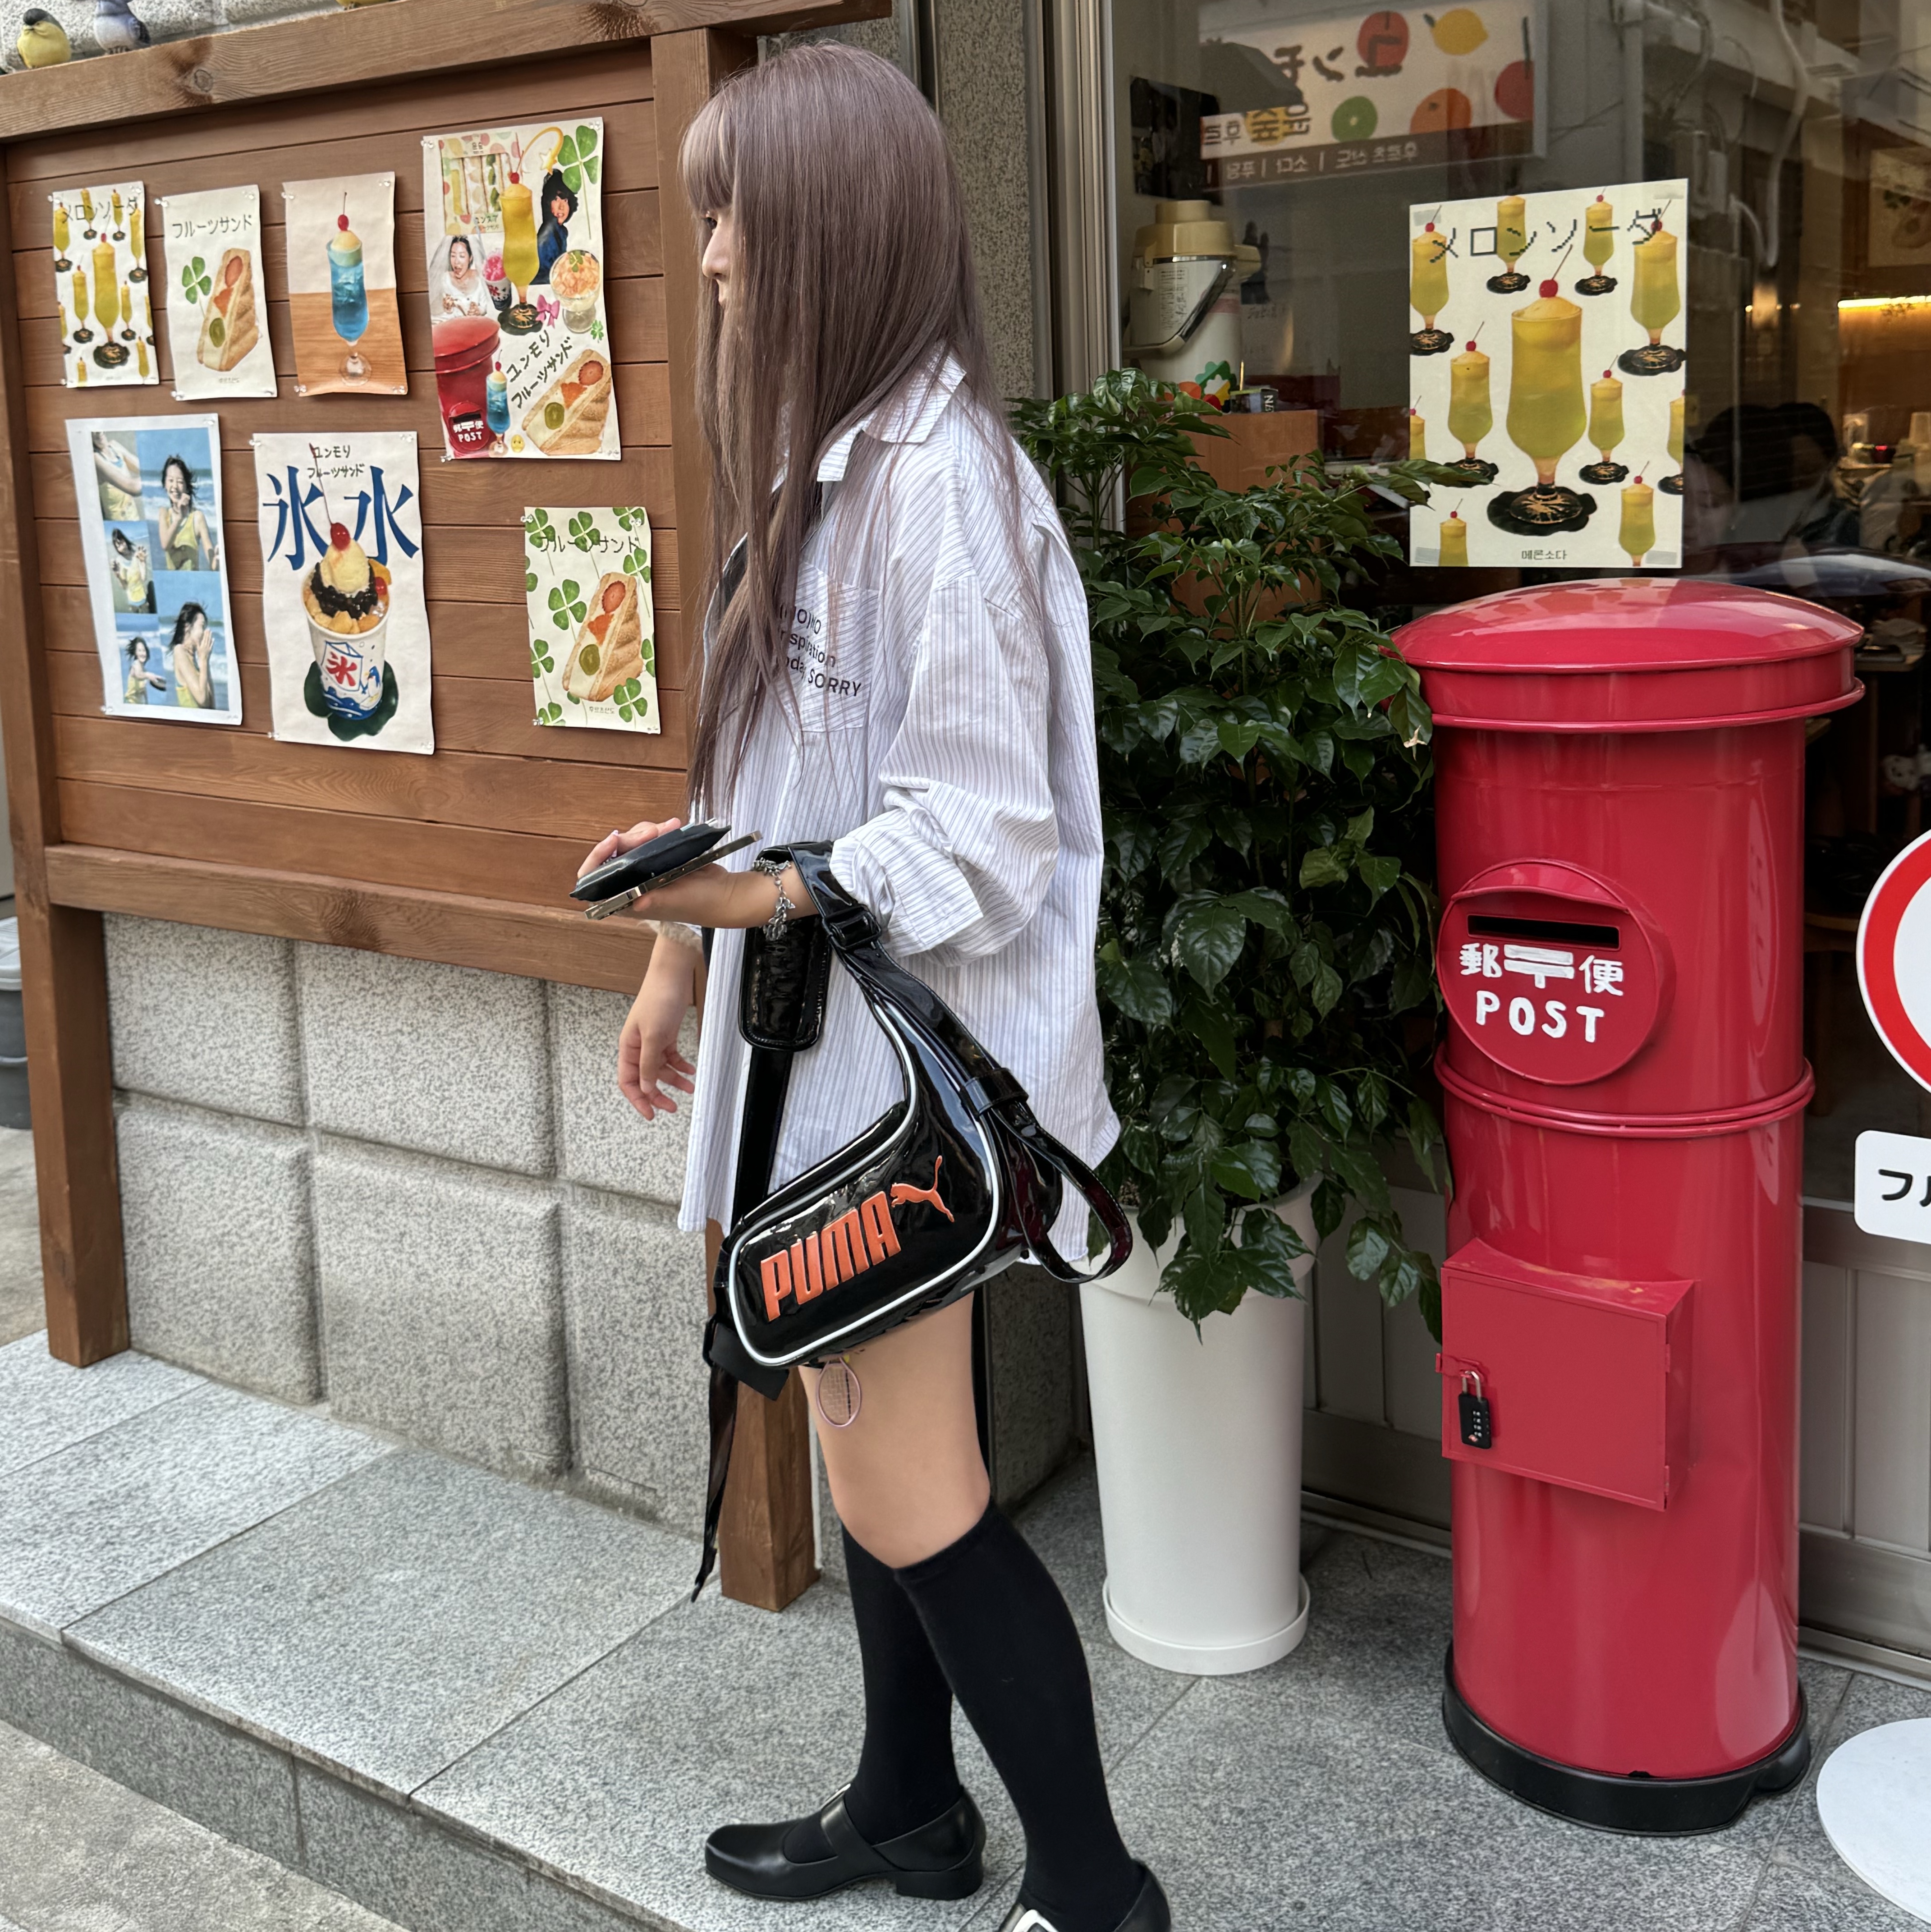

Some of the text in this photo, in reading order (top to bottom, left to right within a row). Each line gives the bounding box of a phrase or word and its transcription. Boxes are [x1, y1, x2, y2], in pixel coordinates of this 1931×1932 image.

[62, 196, 138, 224] メロンソーダ
[172, 214, 252, 239] フルーツサンド
[1430, 208, 1662, 264] メロンソーダ
[511, 336, 573, 409] フルーツサンド
[458, 431, 482, 443] POST
[307, 463, 365, 479] フルーツサンド
[263, 465, 420, 571] 氷水
[1521, 549, 1568, 560] 메론소다
[326, 651, 358, 687] 氷
[808, 668, 862, 697] SORRY
[1476, 990, 1605, 1043] POST
[760, 1190, 902, 1322] PUMA
